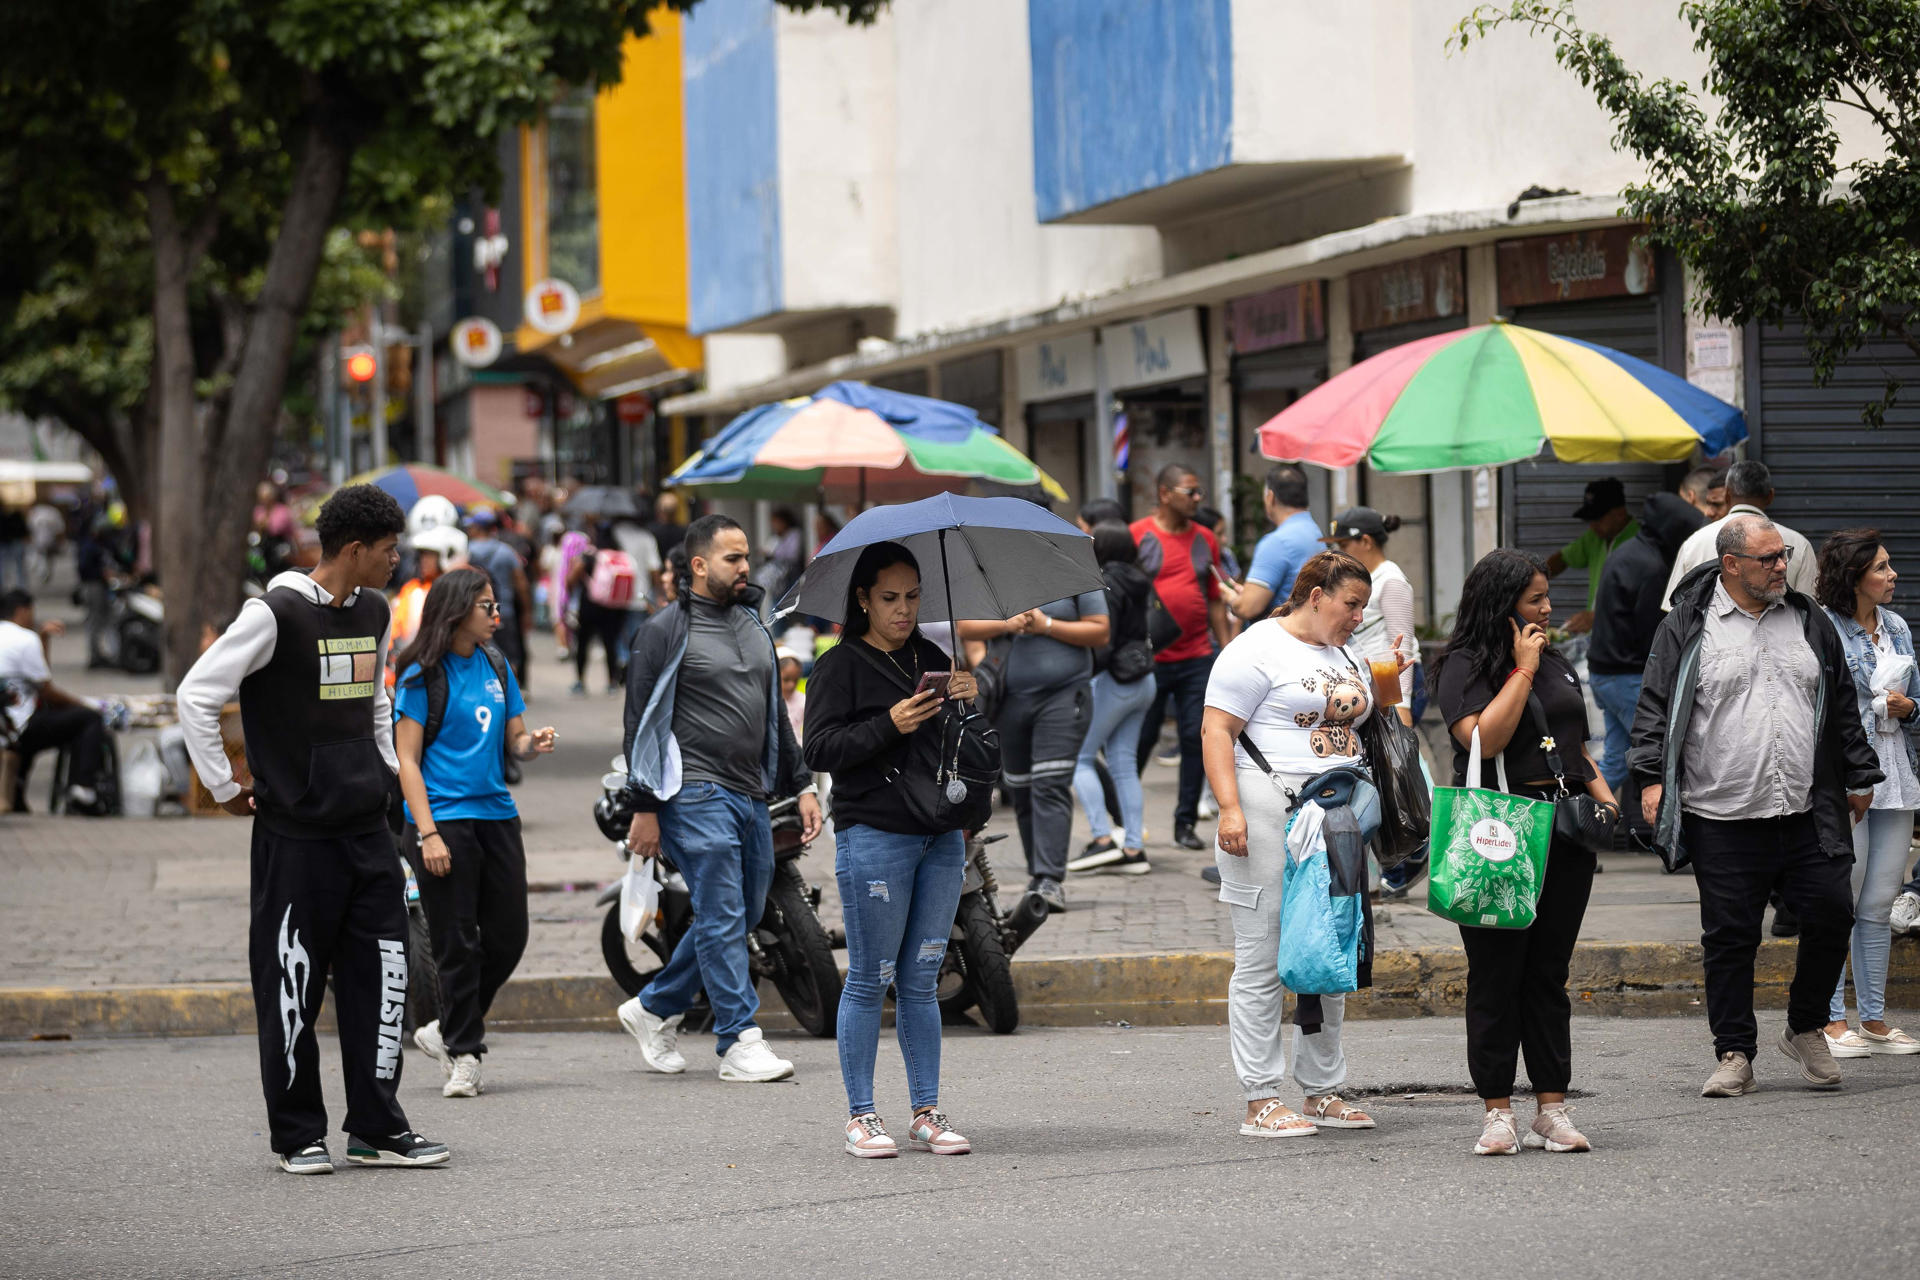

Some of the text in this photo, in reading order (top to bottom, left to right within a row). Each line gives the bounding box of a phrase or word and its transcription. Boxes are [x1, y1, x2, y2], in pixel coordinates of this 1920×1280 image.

[328, 640, 370, 650] TOMMY
[328, 685, 373, 697] HILFIGER
[475, 705, 492, 733] 9
[376, 939, 408, 1080] HELLSTAR
